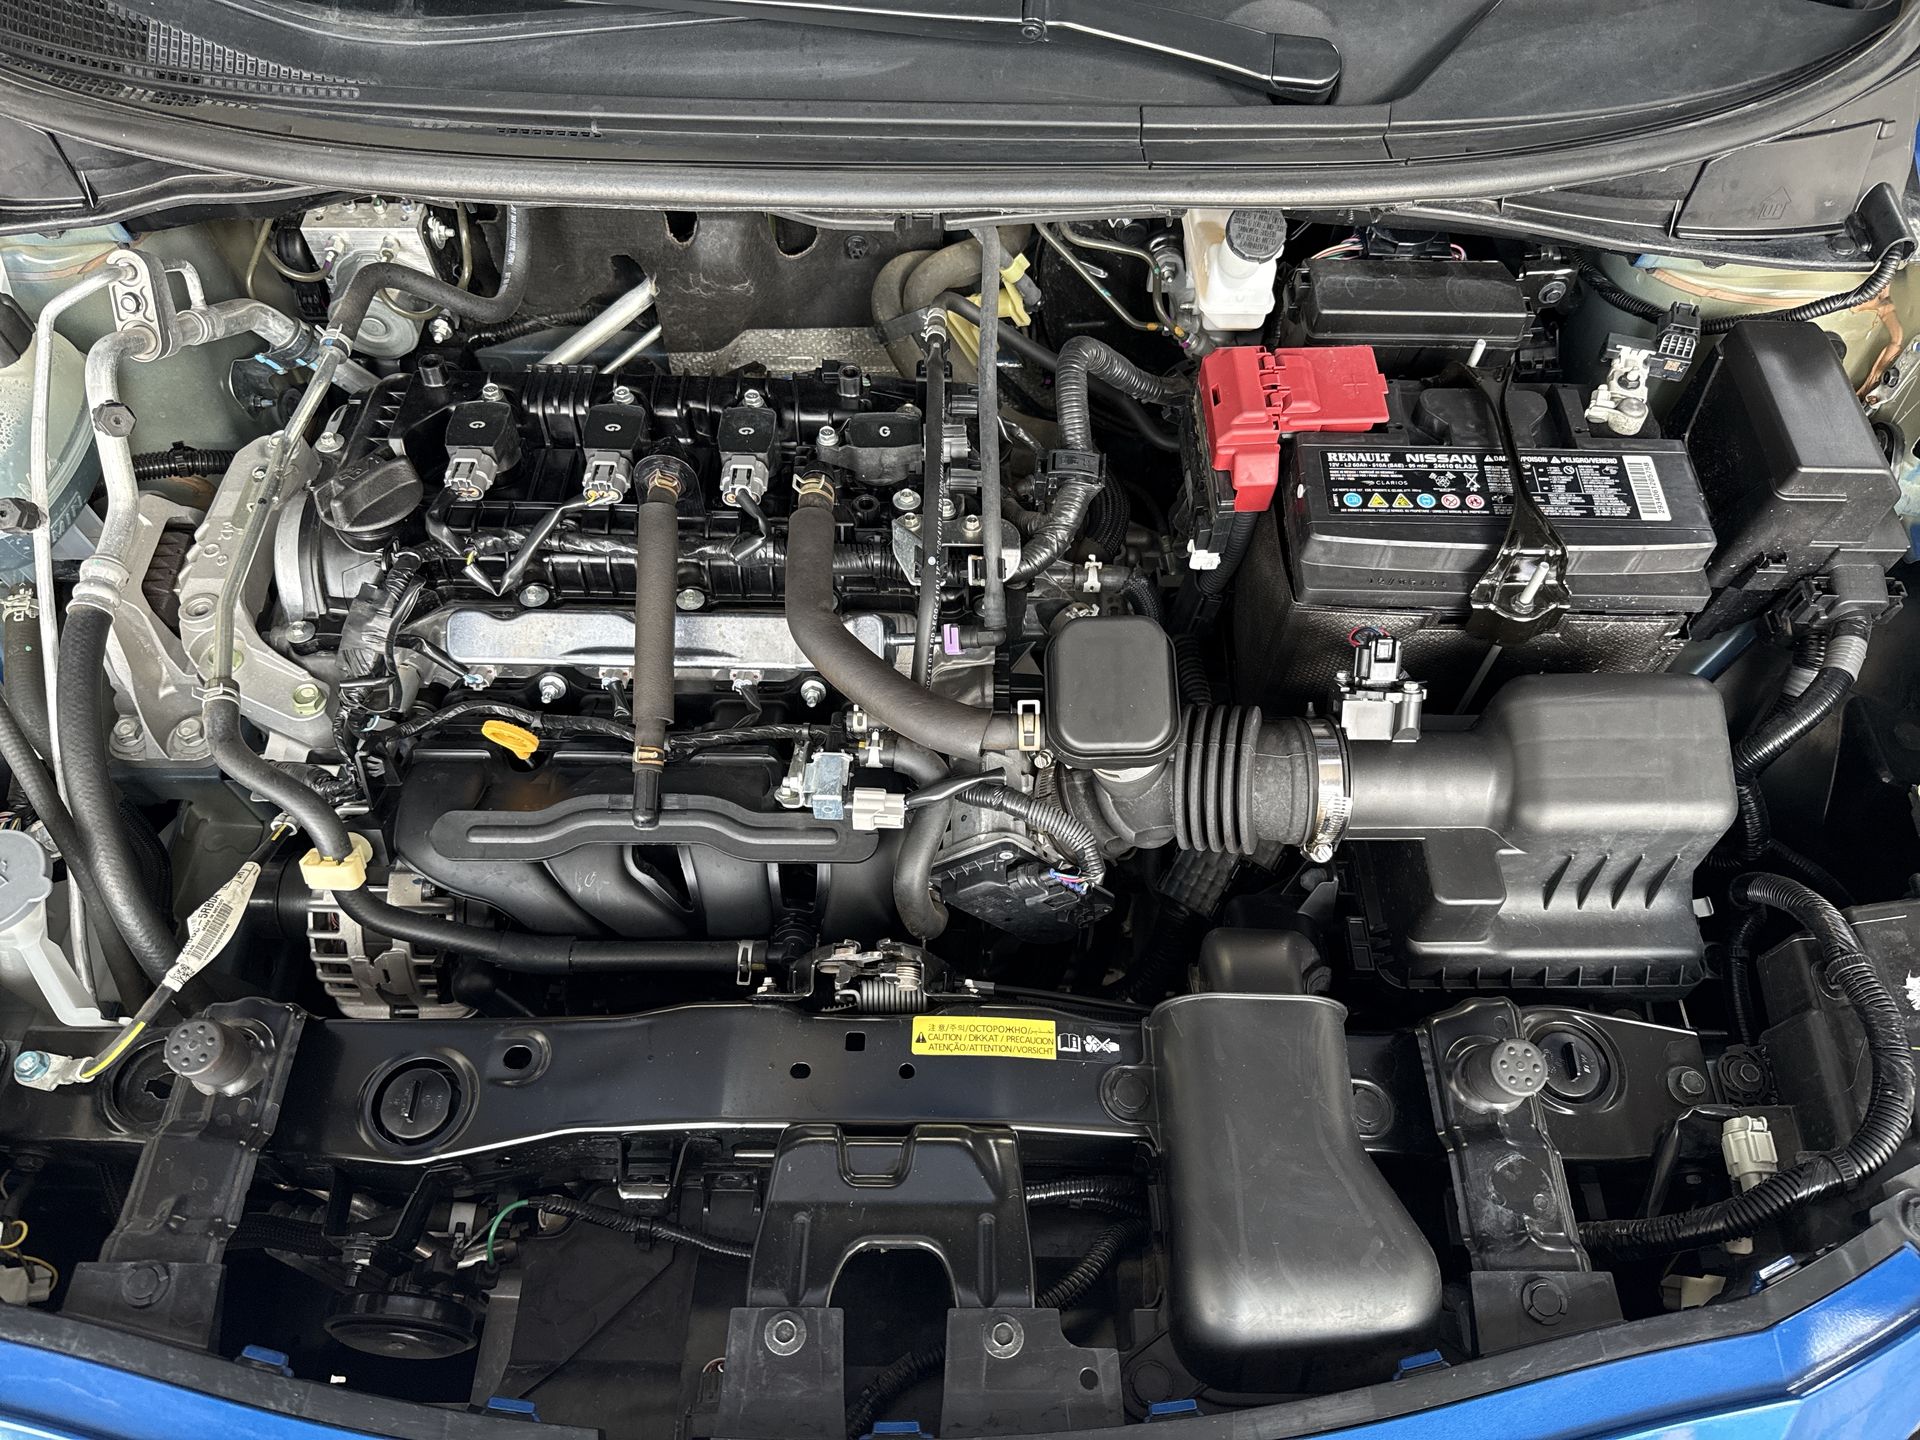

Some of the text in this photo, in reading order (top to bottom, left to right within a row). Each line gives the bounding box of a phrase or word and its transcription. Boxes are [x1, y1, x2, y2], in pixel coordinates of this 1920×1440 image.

[469, 420, 486, 430] G
[604, 423, 622, 433] G
[738, 426, 756, 436] G
[879, 426, 891, 437] G
[1327, 452, 1391, 462] RENAULT
[1405, 453, 1477, 463] NISSAN
[928, 1033, 962, 1041] CAUTION
